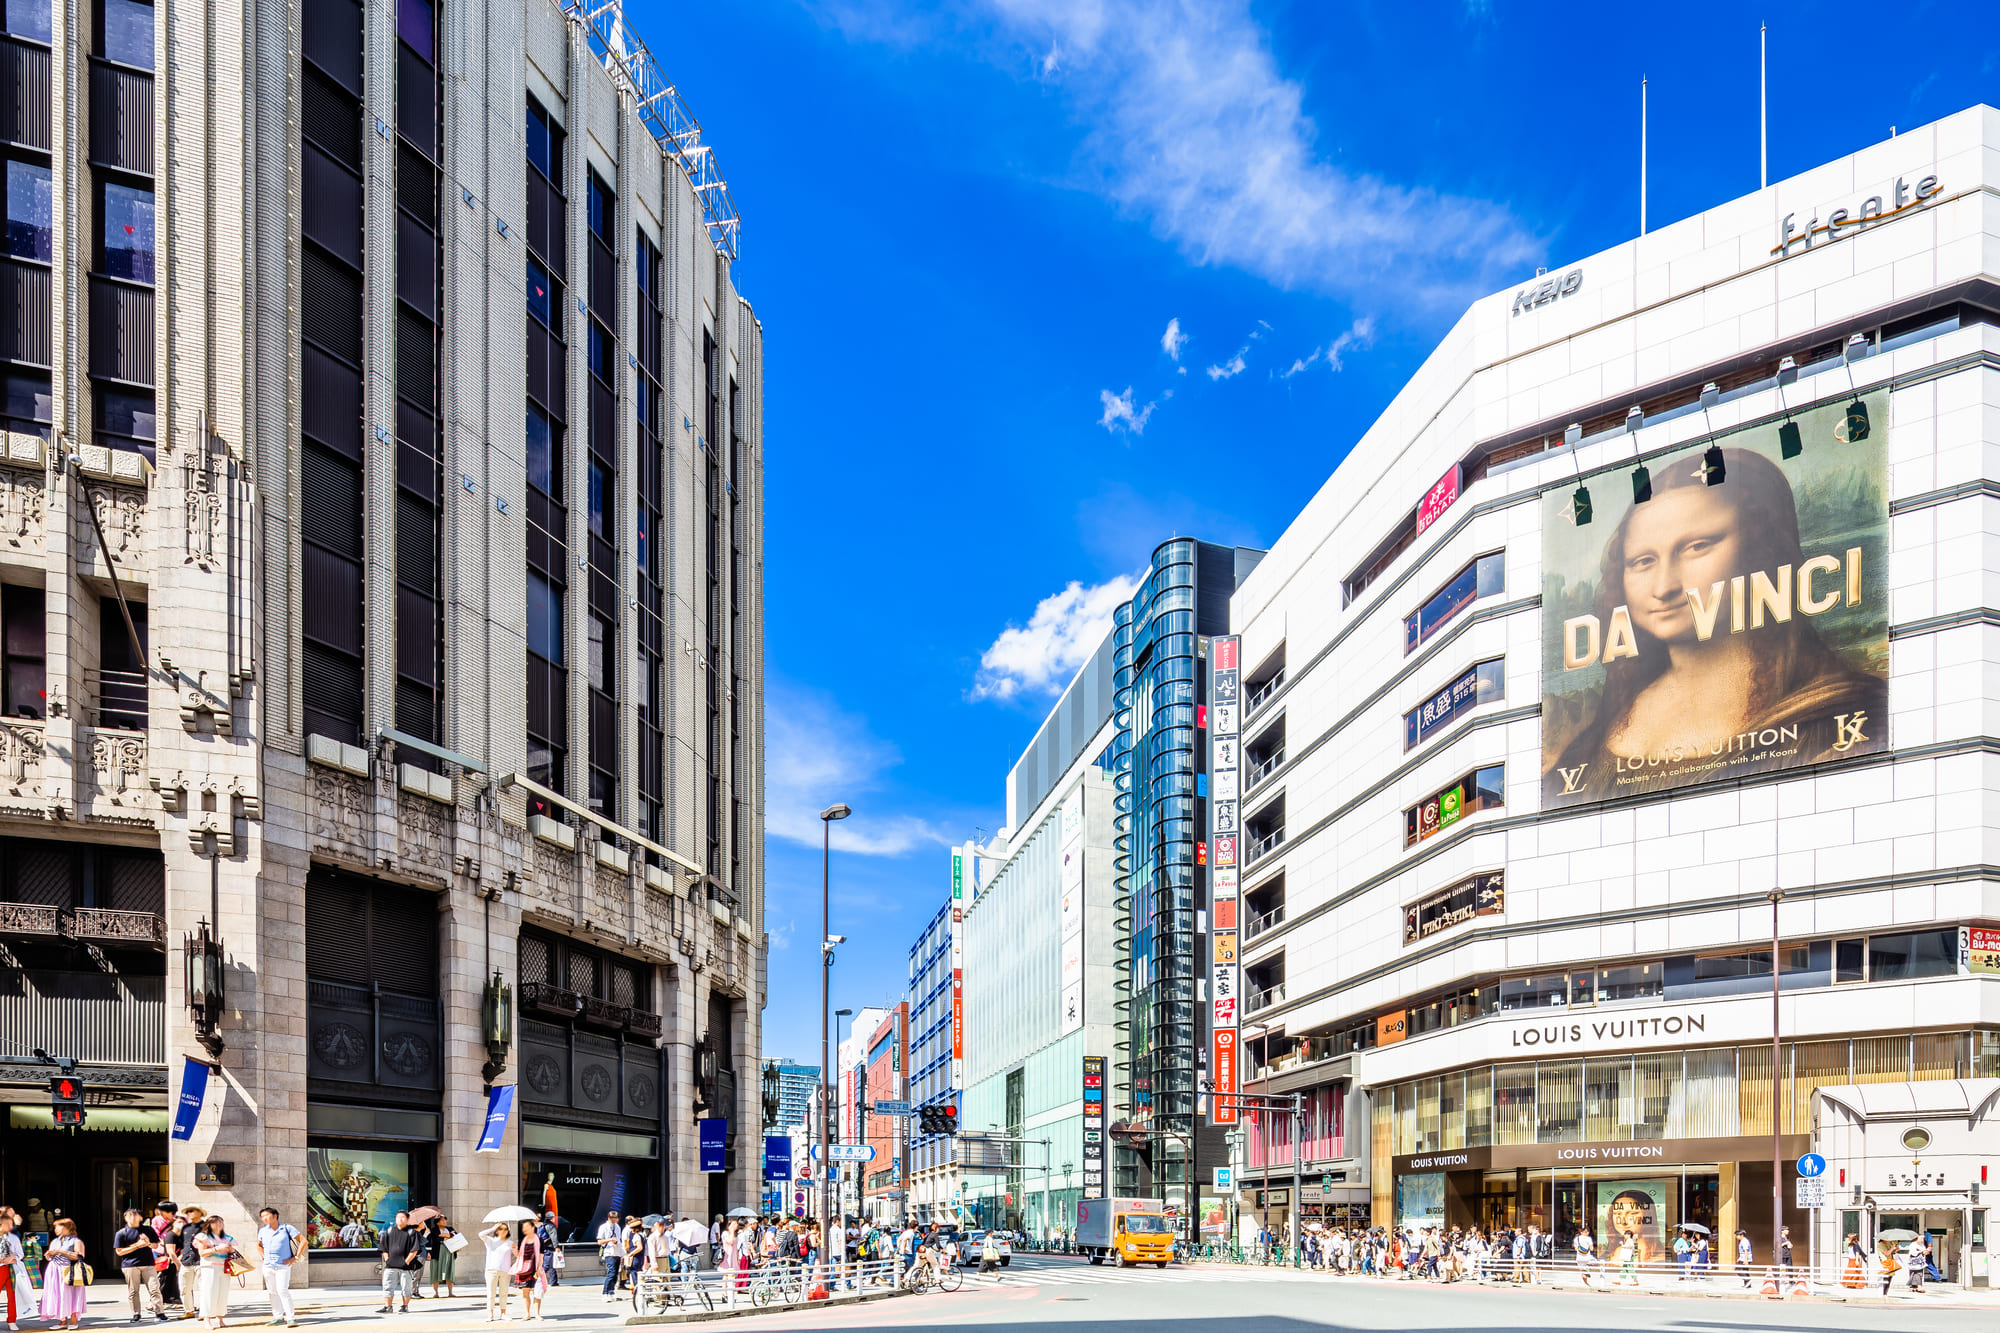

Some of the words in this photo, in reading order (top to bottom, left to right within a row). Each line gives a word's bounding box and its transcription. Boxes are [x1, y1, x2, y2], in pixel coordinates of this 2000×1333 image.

[1782, 174, 1938, 249] frente
[1512, 268, 1583, 314] KEIO
[1564, 605, 1639, 672] DA
[1685, 546, 1862, 642] VINCI
[1616, 746, 1685, 773] LOUIS
[1692, 724, 1798, 759] VUITTON
[1616, 773, 1650, 786] Masters
[1669, 759, 1727, 777] collaboration
[1730, 753, 1749, 765] with
[1751, 749, 1767, 762] Jeff
[1769, 747, 1798, 758] Koons
[1513, 1024, 1581, 1046] LOUIS
[1592, 1014, 1705, 1040] VUITTON
[1411, 1158, 1432, 1168] LOUIS
[1434, 1155, 1468, 1166] VUITTON
[1558, 1148, 1597, 1159] LOUIS
[1602, 1146, 1663, 1158] VUITTON
